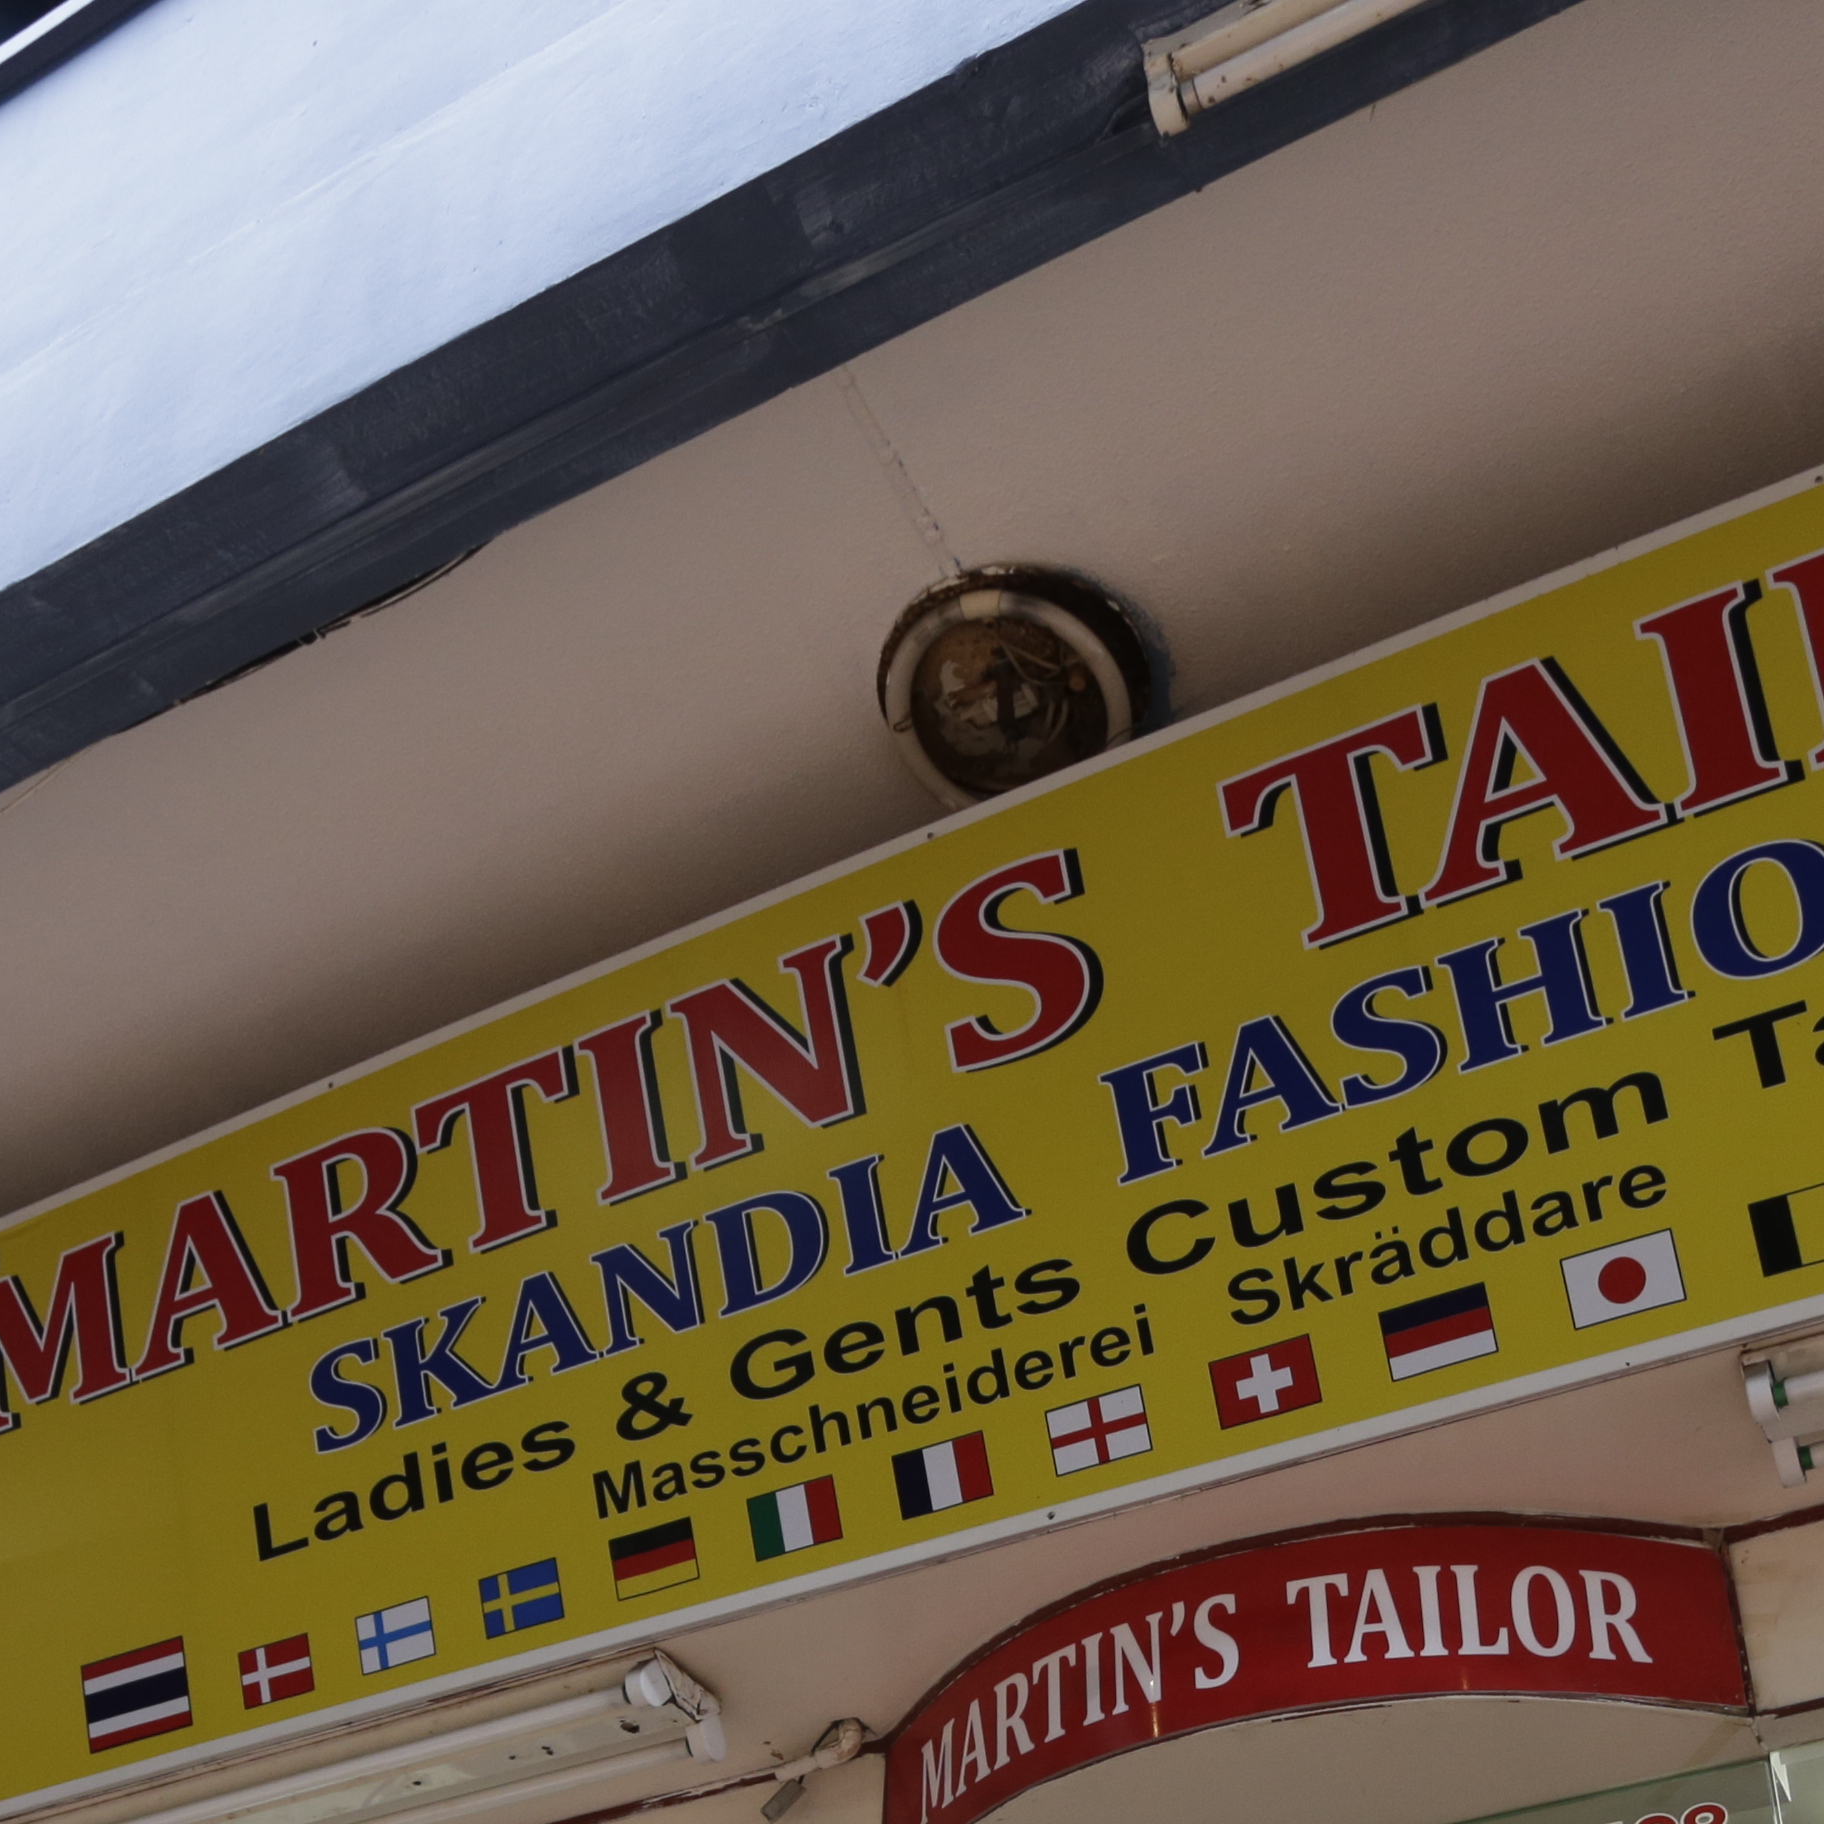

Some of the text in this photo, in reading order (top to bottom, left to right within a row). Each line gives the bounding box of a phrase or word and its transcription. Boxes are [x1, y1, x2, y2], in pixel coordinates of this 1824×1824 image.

[252, 1419, 577, 1562] Ladies
[615, 1371, 694, 1441] &
[728, 1257, 1081, 1401] Gents
[1125, 1070, 1670, 1276] Custom
[308, 1123, 1032, 1455] SKANDIA
[591, 1163, 1669, 1521] Masschneiderei Skräddare
[1285, 1563, 1653, 1669] TAILOR
